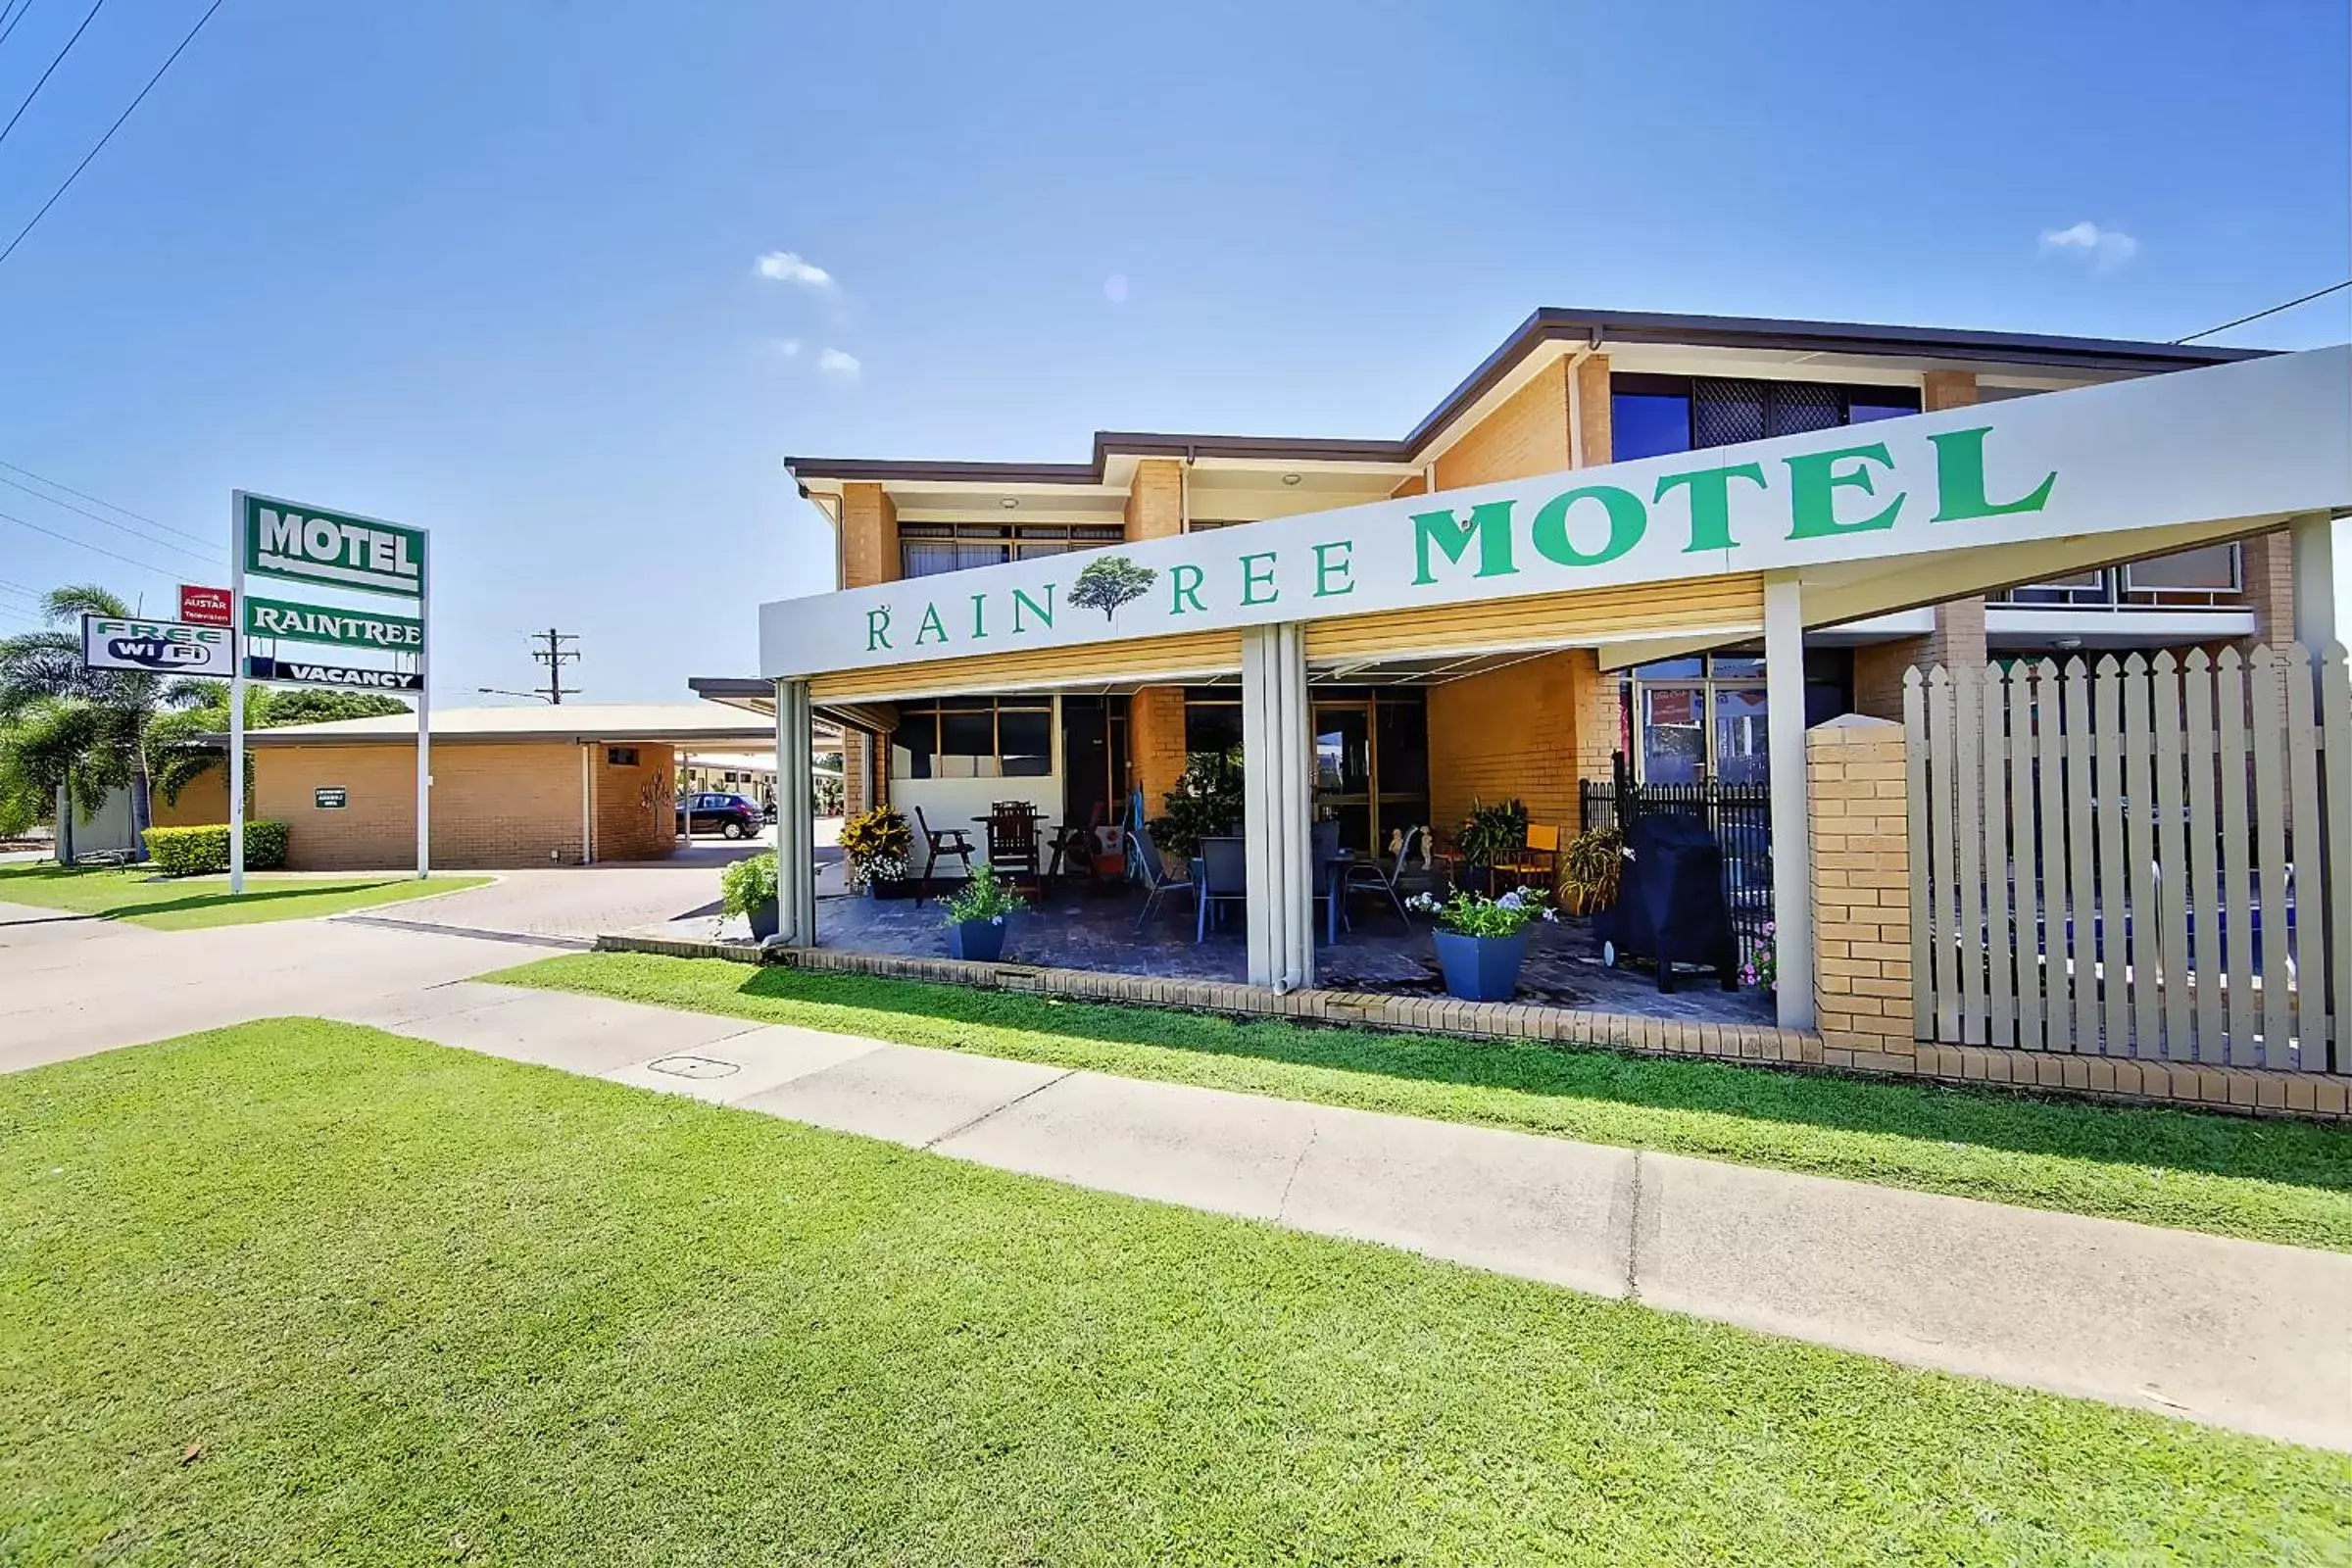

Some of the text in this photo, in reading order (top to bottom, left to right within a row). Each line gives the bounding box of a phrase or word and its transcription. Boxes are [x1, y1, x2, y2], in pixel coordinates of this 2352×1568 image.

[259, 508, 418, 576] MOTEL
[866, 583, 1055, 652] RAIN
[1409, 425, 2057, 586] MOTEL
[184, 599, 226, 610] AUSTAR
[184, 611, 227, 621] Television
[97, 621, 220, 644] FREE
[255, 607, 421, 645] RAINTREE
[289, 663, 415, 688] VACANCY
